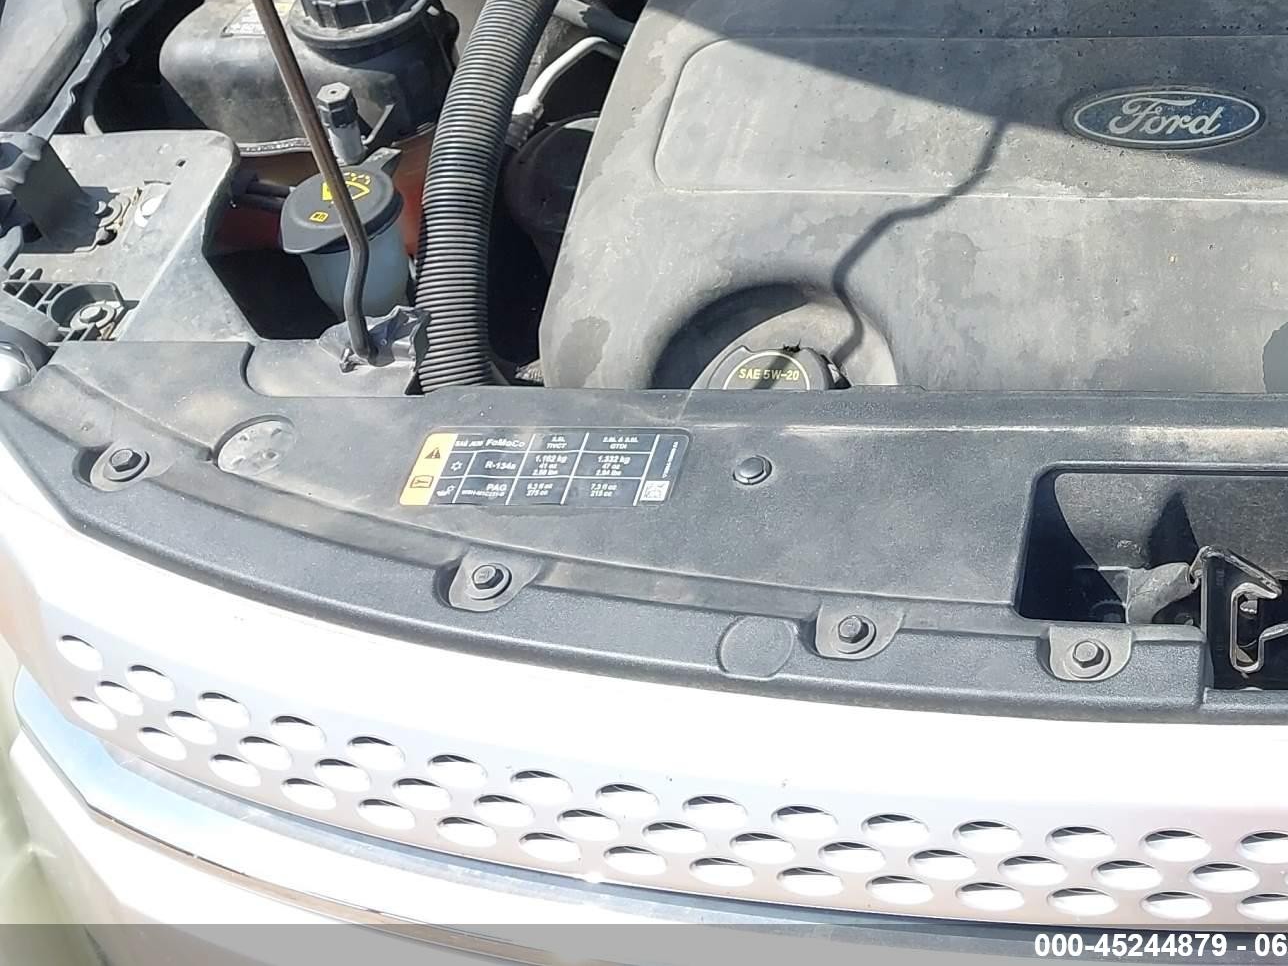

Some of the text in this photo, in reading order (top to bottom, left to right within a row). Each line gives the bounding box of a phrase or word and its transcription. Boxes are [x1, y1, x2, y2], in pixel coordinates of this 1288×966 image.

[1108, 97, 1225, 135] Ford
[738, 368, 800, 381] SAE 5W-20
[485, 438, 526, 447] FoMoCo
[484, 460, 517, 470] R-134a
[619, 455, 631, 465] kg
[486, 483, 507, 491] PAG
